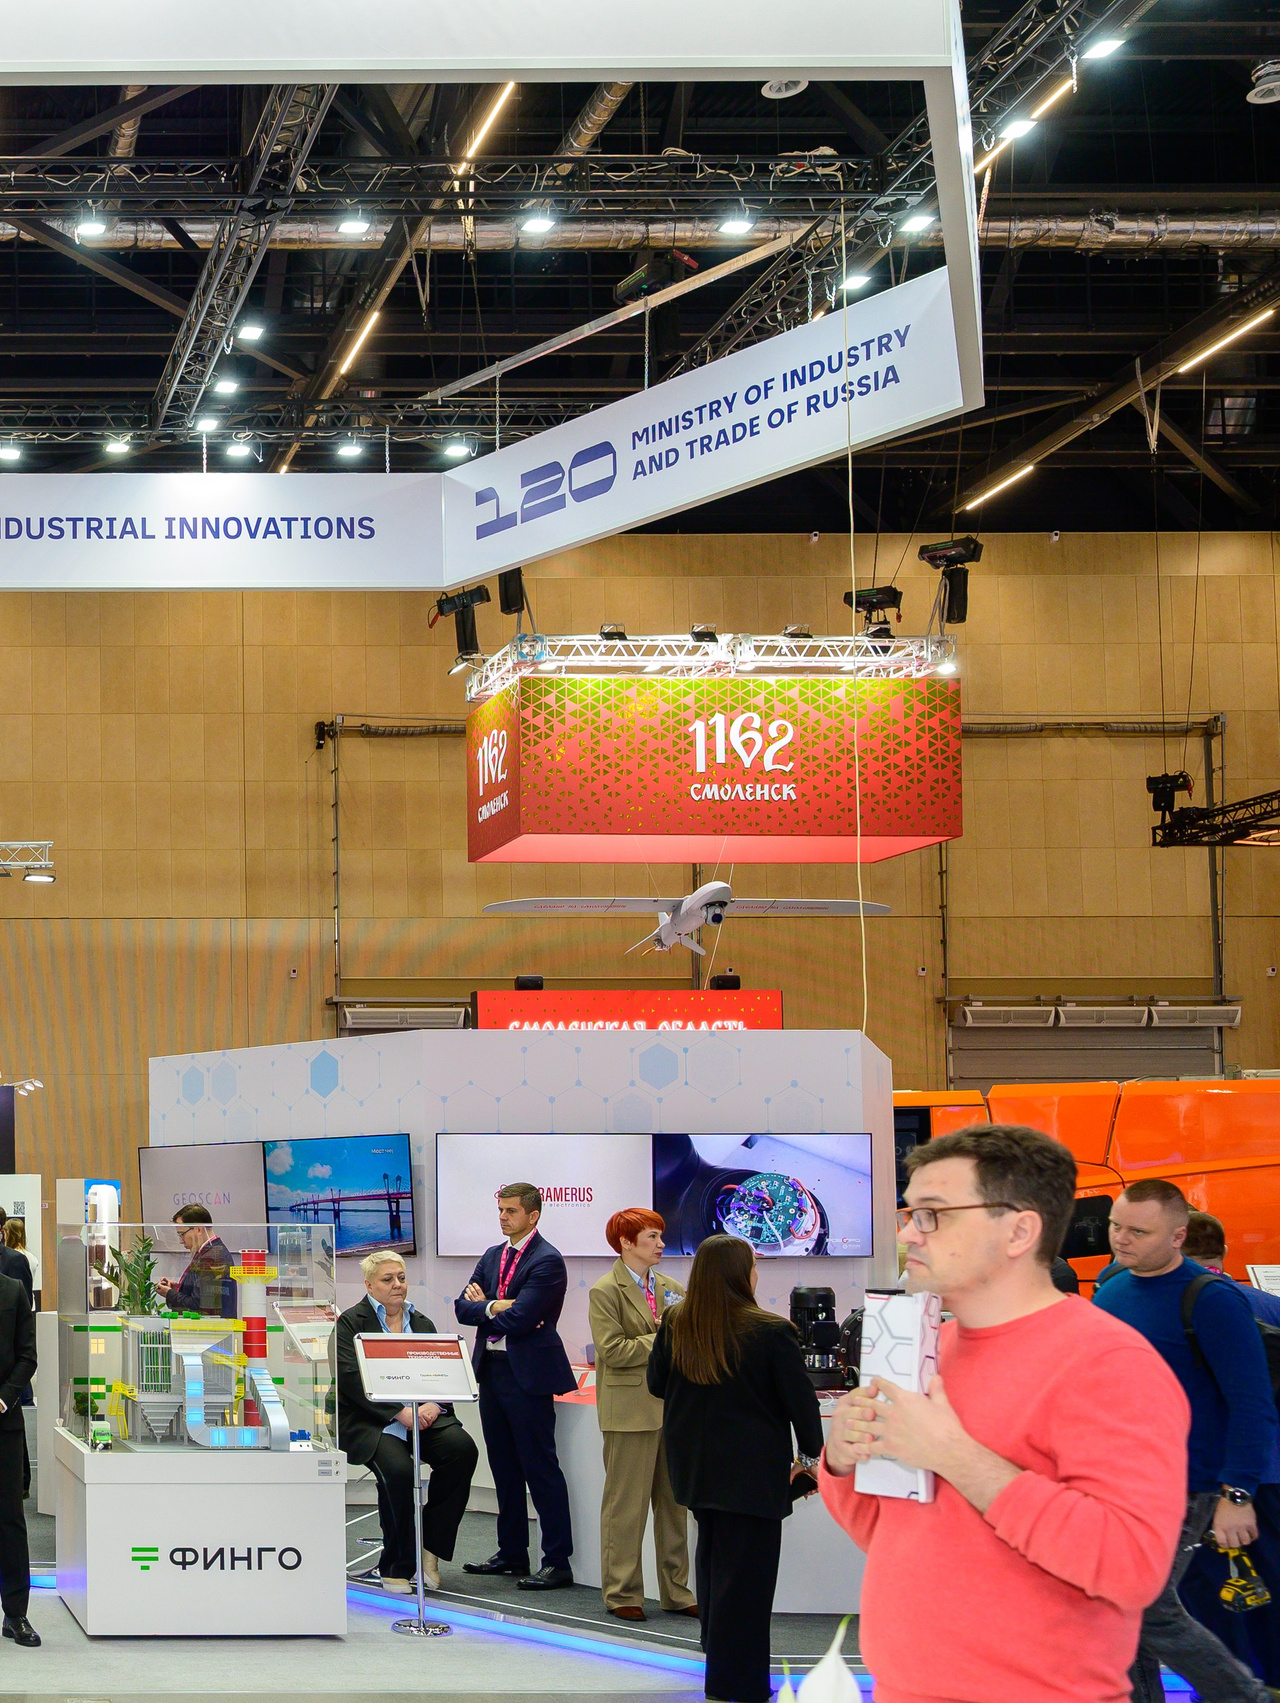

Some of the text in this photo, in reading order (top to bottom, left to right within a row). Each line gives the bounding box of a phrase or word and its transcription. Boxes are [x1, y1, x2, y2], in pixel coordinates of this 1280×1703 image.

[631, 324, 911, 450] MINISTRY OF INDUSTRY
[632, 364, 900, 480] AND TRADE OF RUSSIA
[475, 440, 617, 540] 120
[164, 517, 376, 541] INNOVATIONS
[477, 729, 508, 796] 1162
[688, 711, 795, 773] 1162
[690, 783, 797, 802] СМОЛЕНСК
[173, 1192, 231, 1205] GEOSCAN
[168, 1546, 303, 1571] ФИНГО
